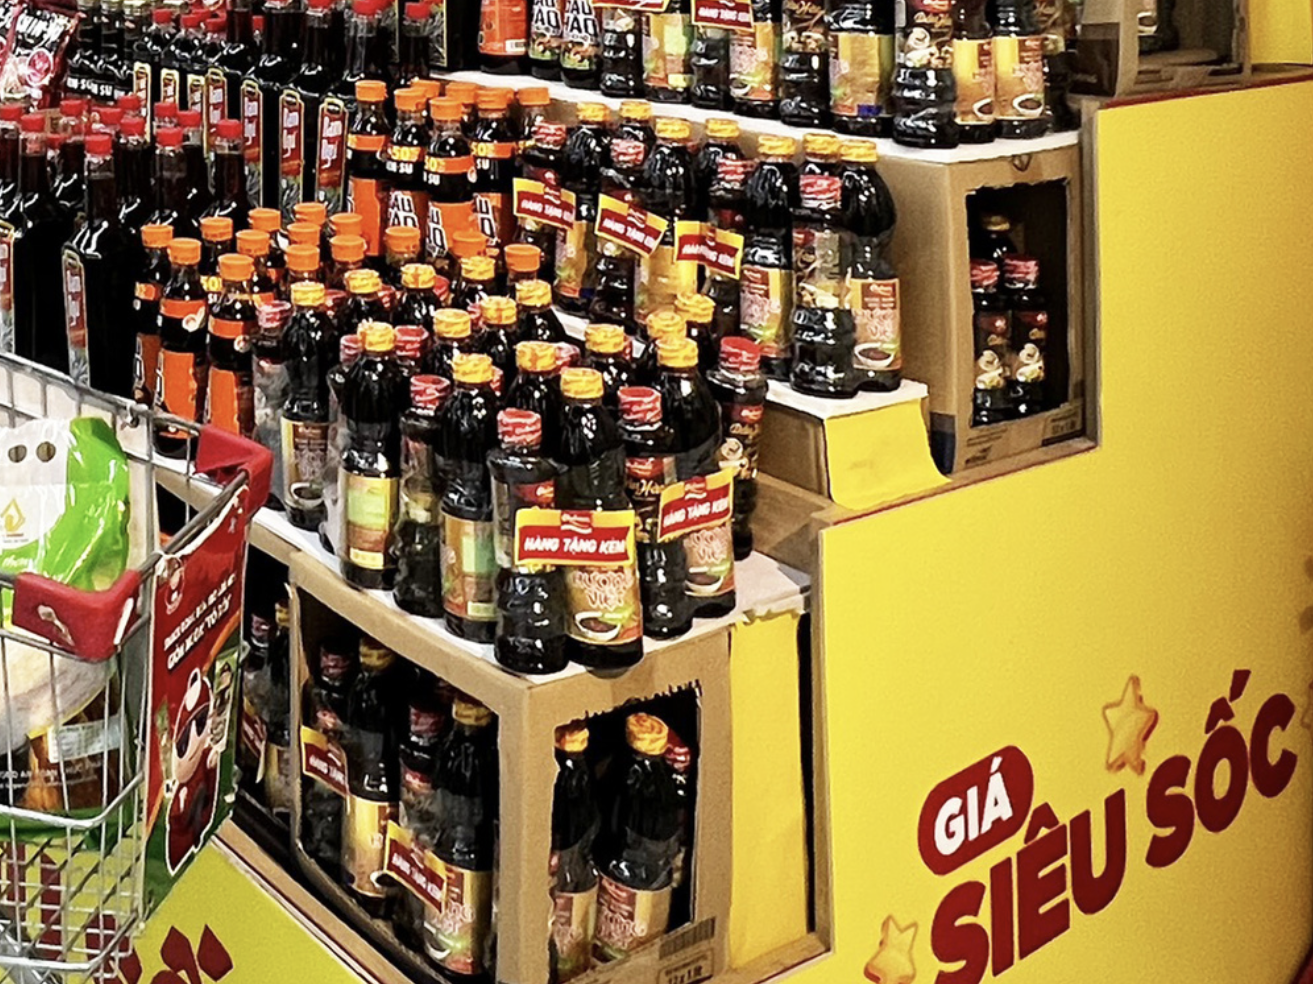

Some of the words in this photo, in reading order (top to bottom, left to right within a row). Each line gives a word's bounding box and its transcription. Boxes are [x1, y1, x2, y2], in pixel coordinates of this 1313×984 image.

[688, 502, 711, 521] TẶNG
[523, 536, 559, 552] HÀNG
[563, 536, 597, 555] TẶNG
[599, 537, 627, 554] KÈM
[930, 788, 1127, 984] SIÊU
[1145, 669, 1298, 868] SỐC
[934, 756, 1013, 856] GIÁ
